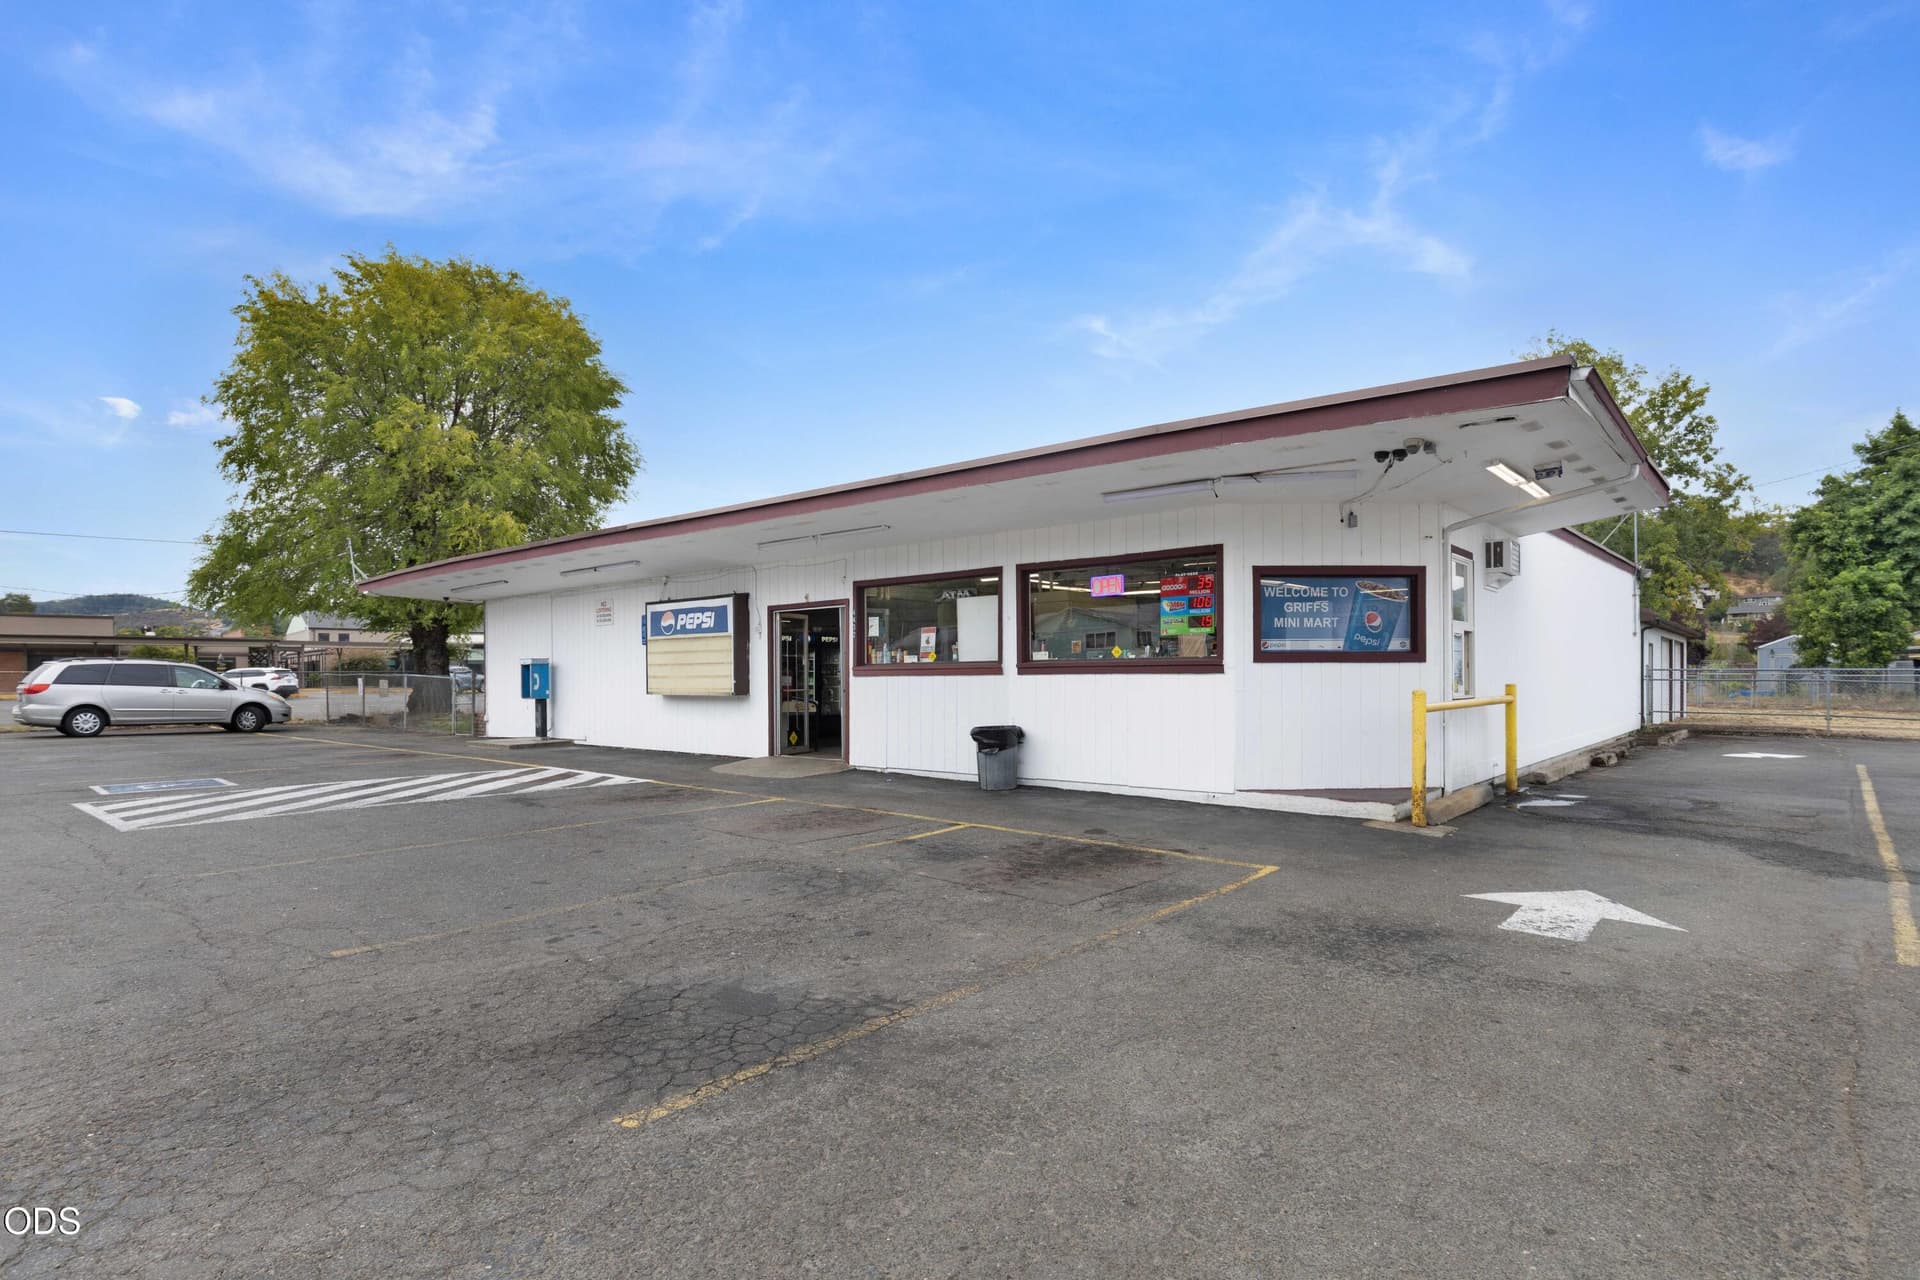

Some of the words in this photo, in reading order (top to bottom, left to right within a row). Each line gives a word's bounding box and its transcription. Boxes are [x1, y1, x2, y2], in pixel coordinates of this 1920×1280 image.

[1093, 576, 1122, 595] OPEN
[1198, 577, 1213, 589] 35
[1264, 586, 1329, 597] WELCOME
[1331, 586, 1349, 597] TO
[1284, 601, 1329, 613] GRIFFS
[676, 611, 715, 630] PEPSI
[1274, 617, 1300, 628] MINI
[1303, 617, 1340, 628] MART
[1354, 633, 1381, 646] pepsi
